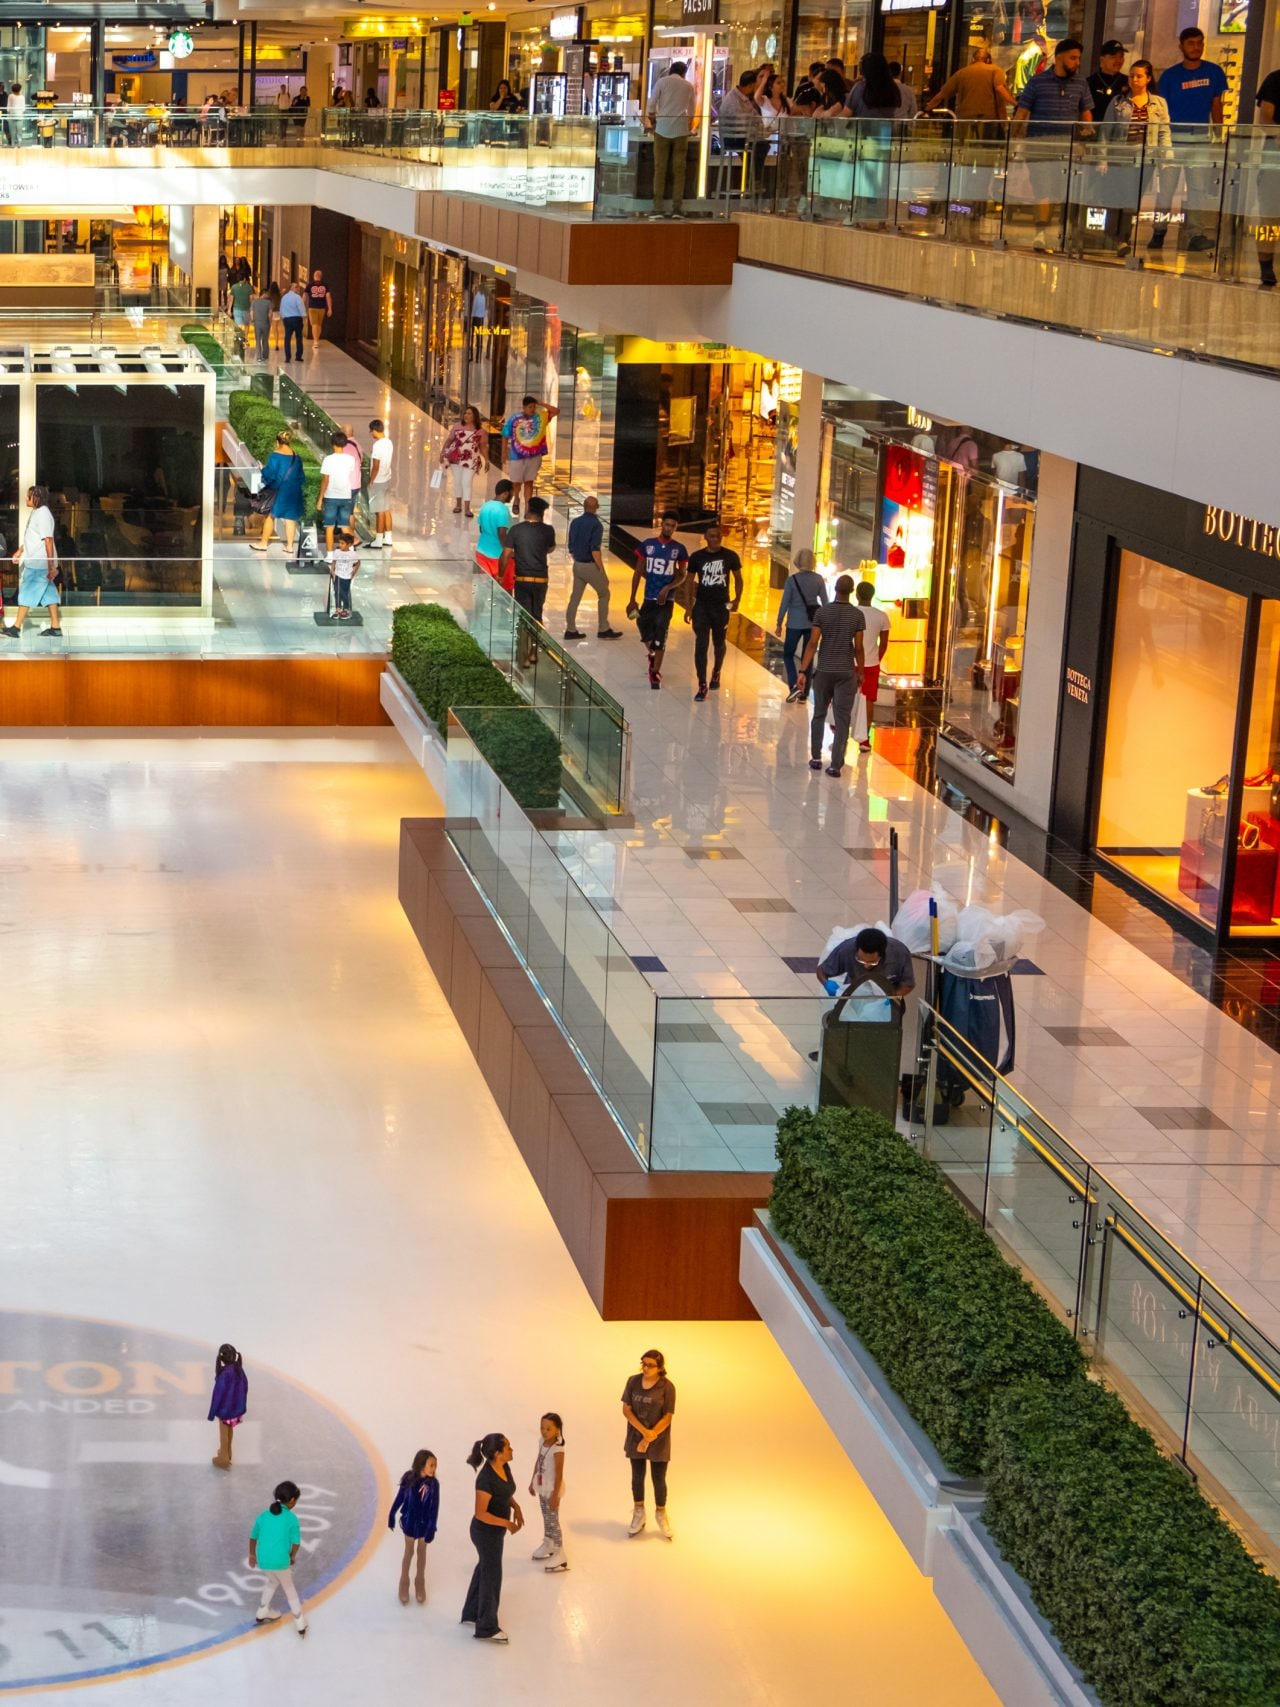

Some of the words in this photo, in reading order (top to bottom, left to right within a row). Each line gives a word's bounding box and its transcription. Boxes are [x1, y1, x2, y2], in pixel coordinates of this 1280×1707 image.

[311, 285, 326, 298] 99
[646, 557, 675, 576] USA
[1067, 667, 1090, 690] BOTTEGA
[1067, 682, 1088, 704] VENETA
[43, 1620, 131, 1661] 11
